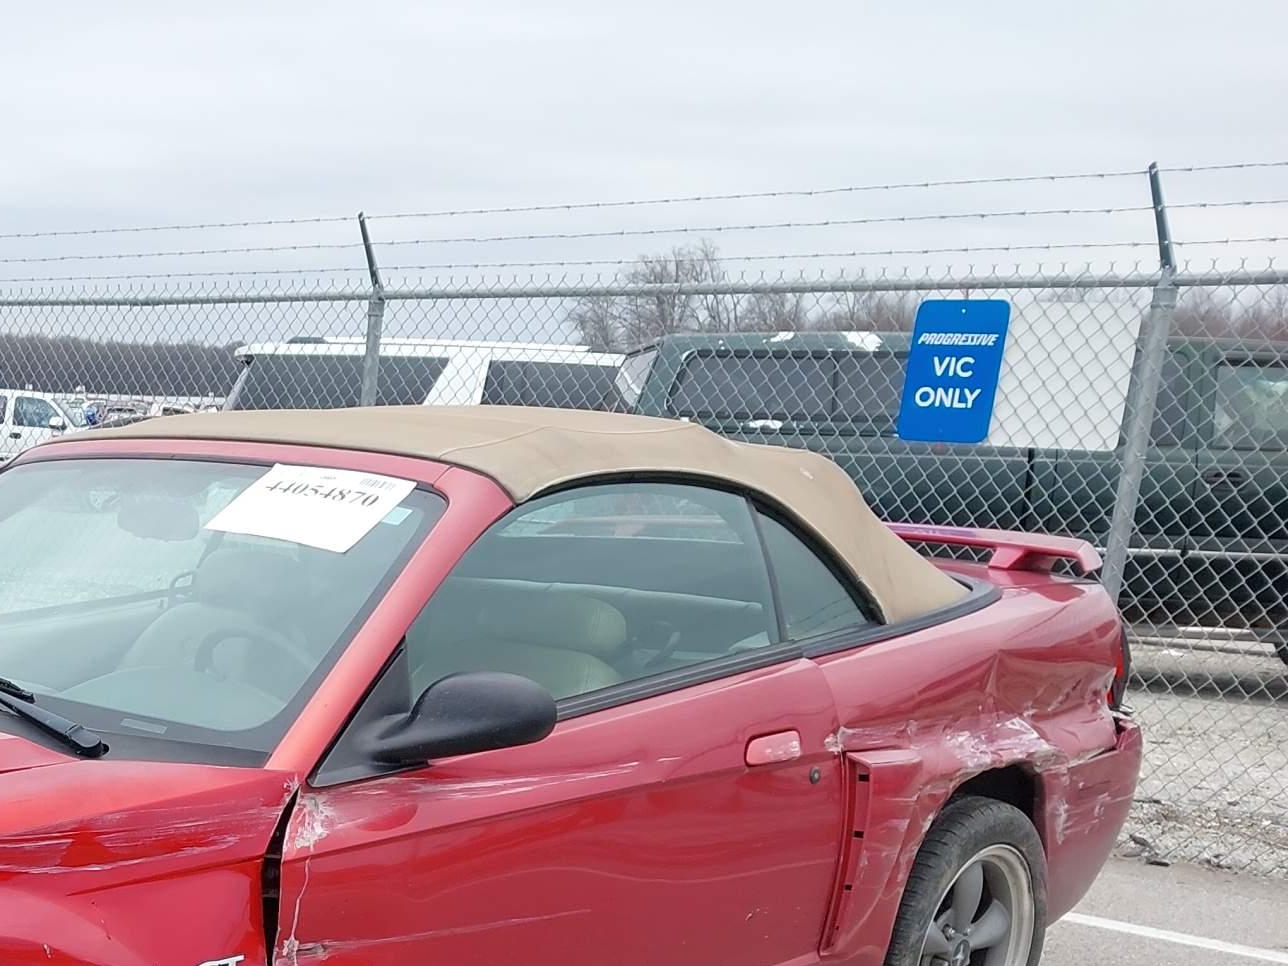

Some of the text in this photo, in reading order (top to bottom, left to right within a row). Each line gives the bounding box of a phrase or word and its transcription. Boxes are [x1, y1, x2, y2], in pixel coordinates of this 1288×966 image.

[917, 333, 999, 346] PROGRESSIVE
[933, 356, 975, 378] VIC
[914, 386, 982, 409] ONLY
[265, 480, 380, 508] 44054870
